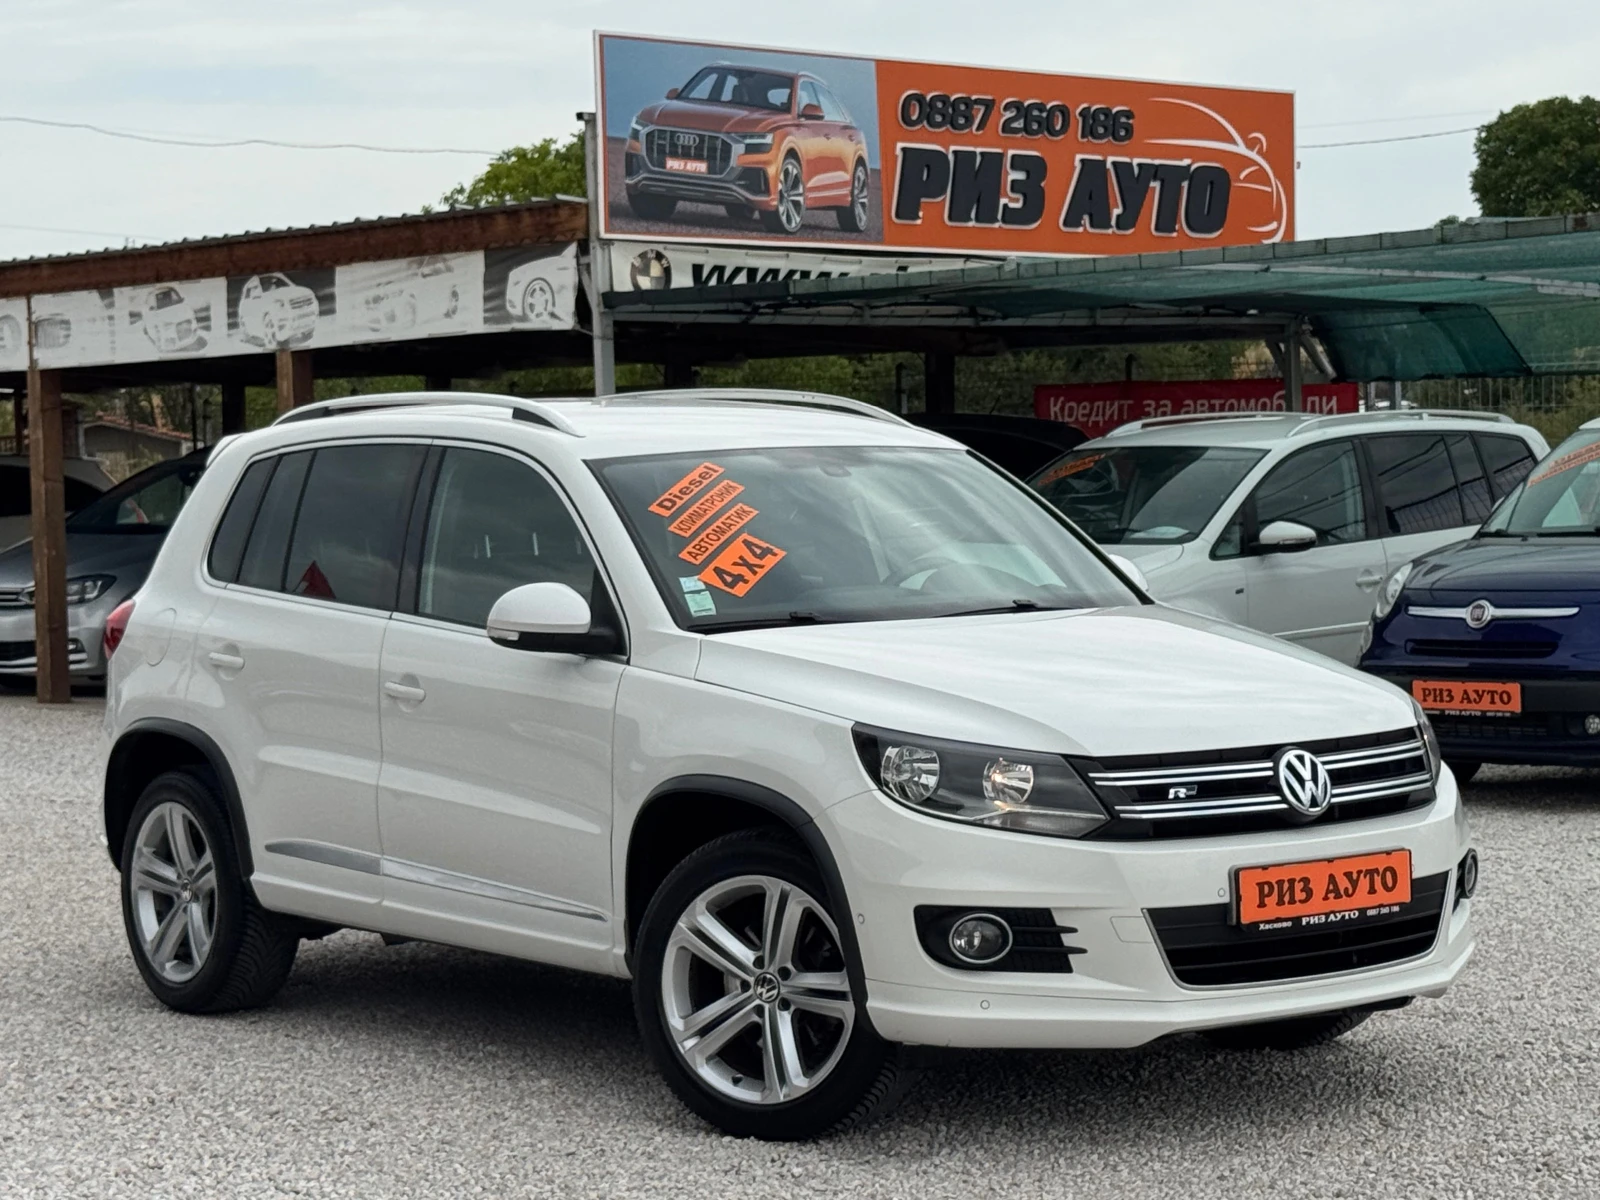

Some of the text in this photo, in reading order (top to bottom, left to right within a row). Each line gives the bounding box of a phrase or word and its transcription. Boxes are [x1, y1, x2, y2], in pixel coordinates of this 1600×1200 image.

[900, 90, 1135, 144] 0887 260 186
[892, 142, 1231, 238] РИЗ АУТО
[1050, 390, 1337, 427] Кредит за автомобли
[656, 464, 719, 511] Diesel
[674, 481, 739, 533] КЛИМАТРОНИК
[687, 505, 753, 561] АВТОМАТИК
[1421, 688, 1512, 705] РИЗ АУТО
[1256, 866, 1398, 908] РИЗ АУТО
[1301, 915, 1325, 925] РИЗ
[1327, 910, 1359, 922] АУТО
